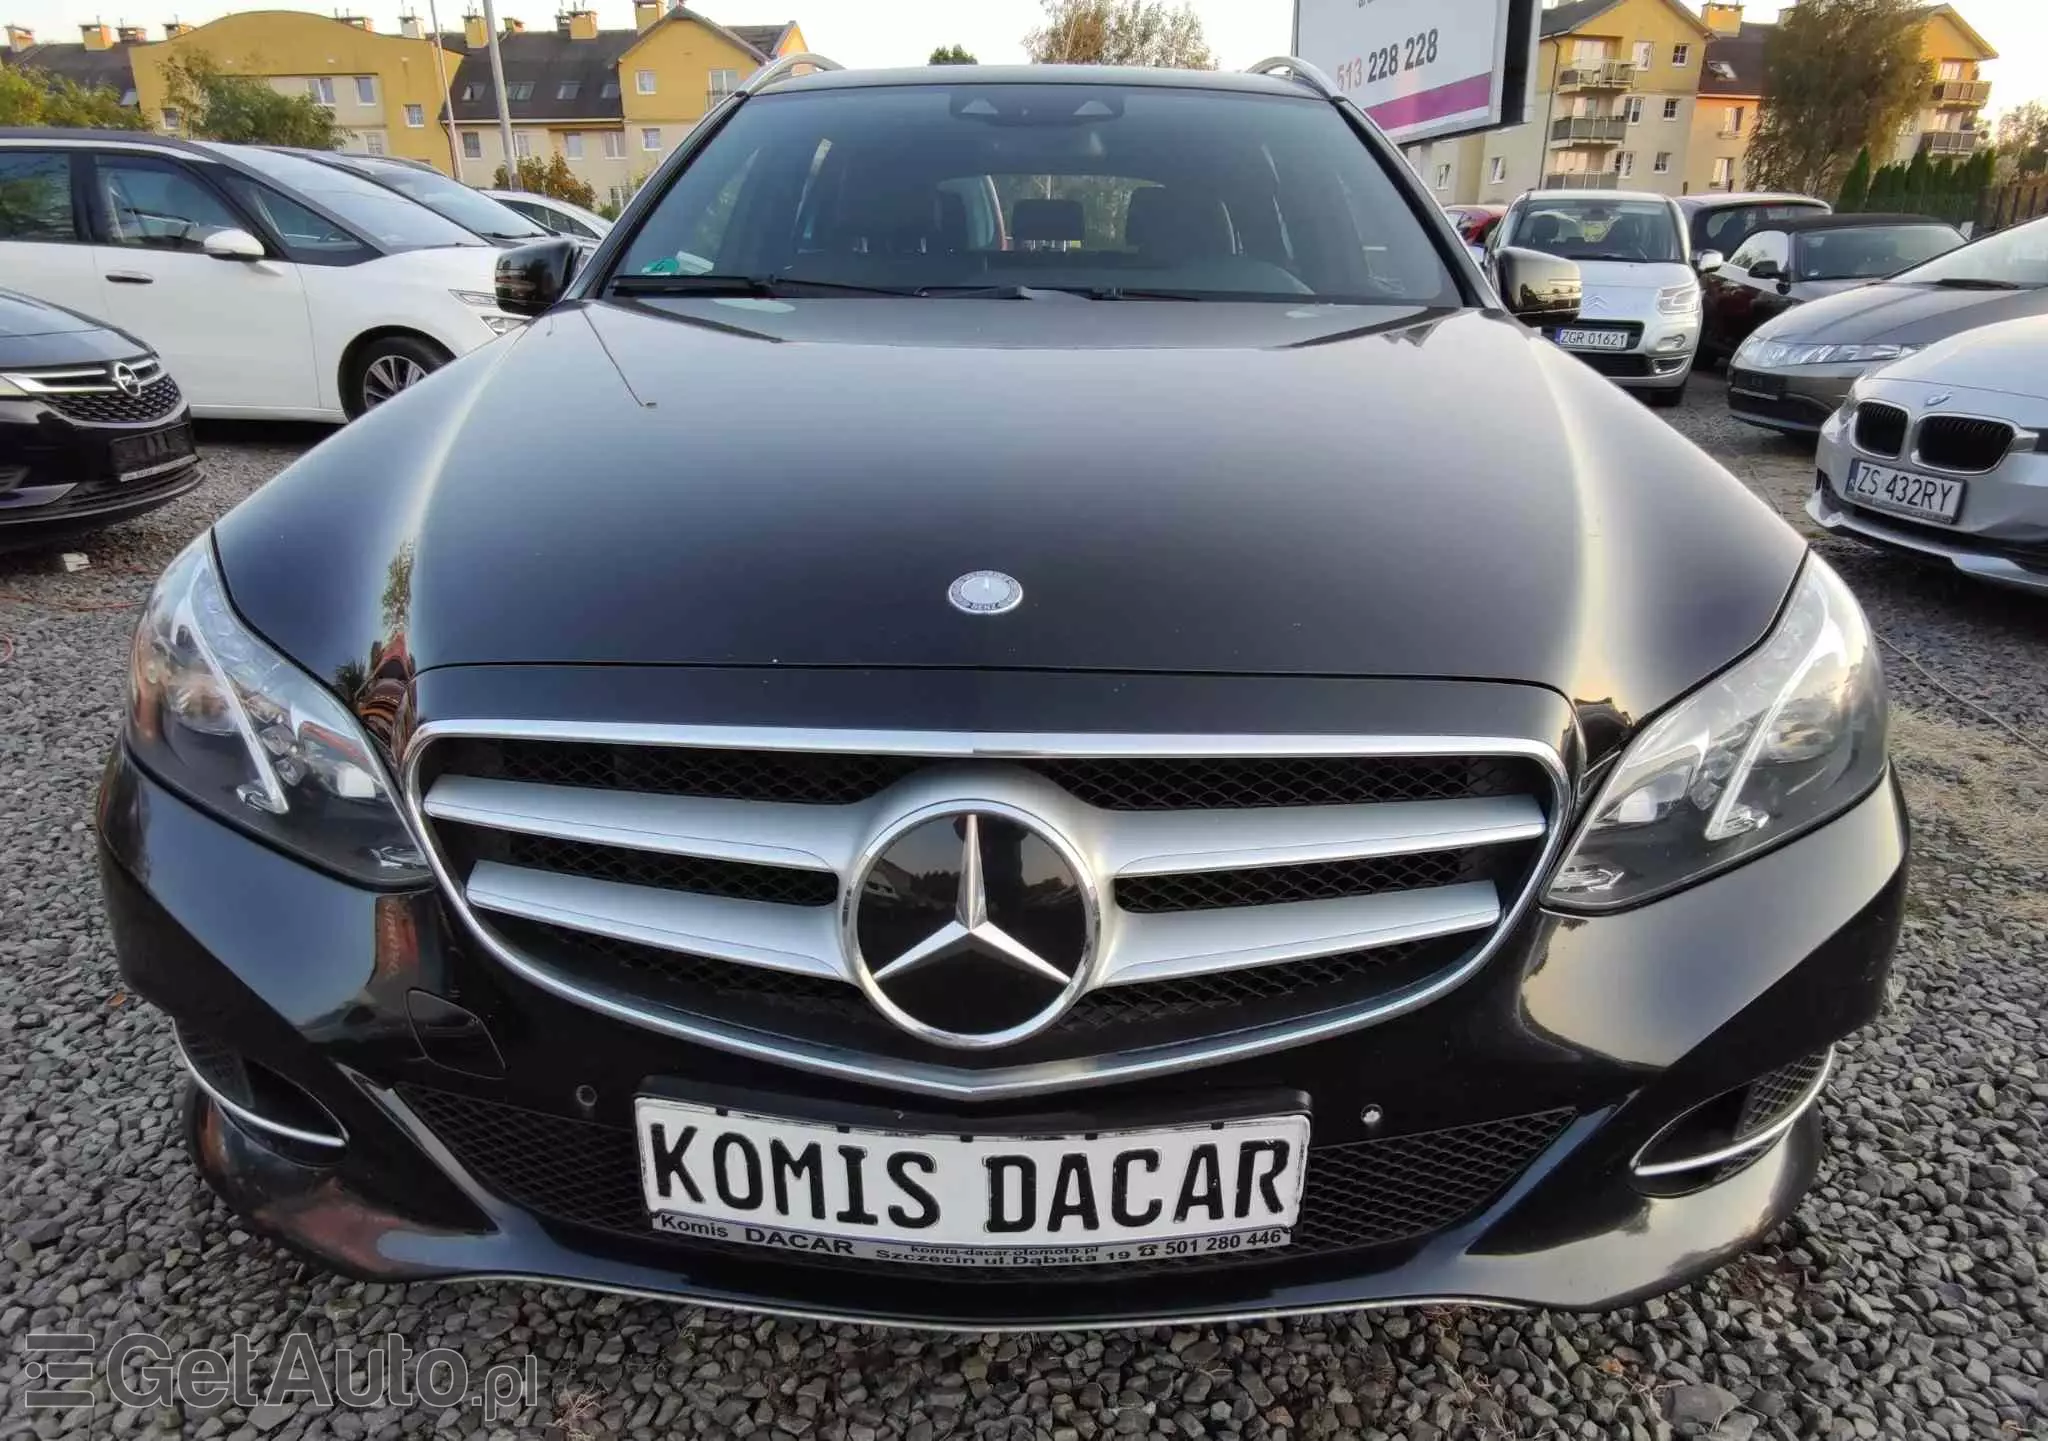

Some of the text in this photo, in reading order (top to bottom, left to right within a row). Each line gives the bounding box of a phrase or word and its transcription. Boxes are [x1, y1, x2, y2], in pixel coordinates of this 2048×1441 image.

[1337, 28, 1439, 92] 513 228 228
[1560, 331, 1626, 347] ZGR 01621
[1857, 465, 1954, 512] ZS 432RY
[650, 1122, 1290, 1234] KOMIS DACAR
[661, 1213, 854, 1255] Komis DACAR
[1165, 1229, 1282, 1256] 501 280 446
[875, 1249, 976, 1265] Szczecin
[1106, 1251, 1131, 1261] 19
